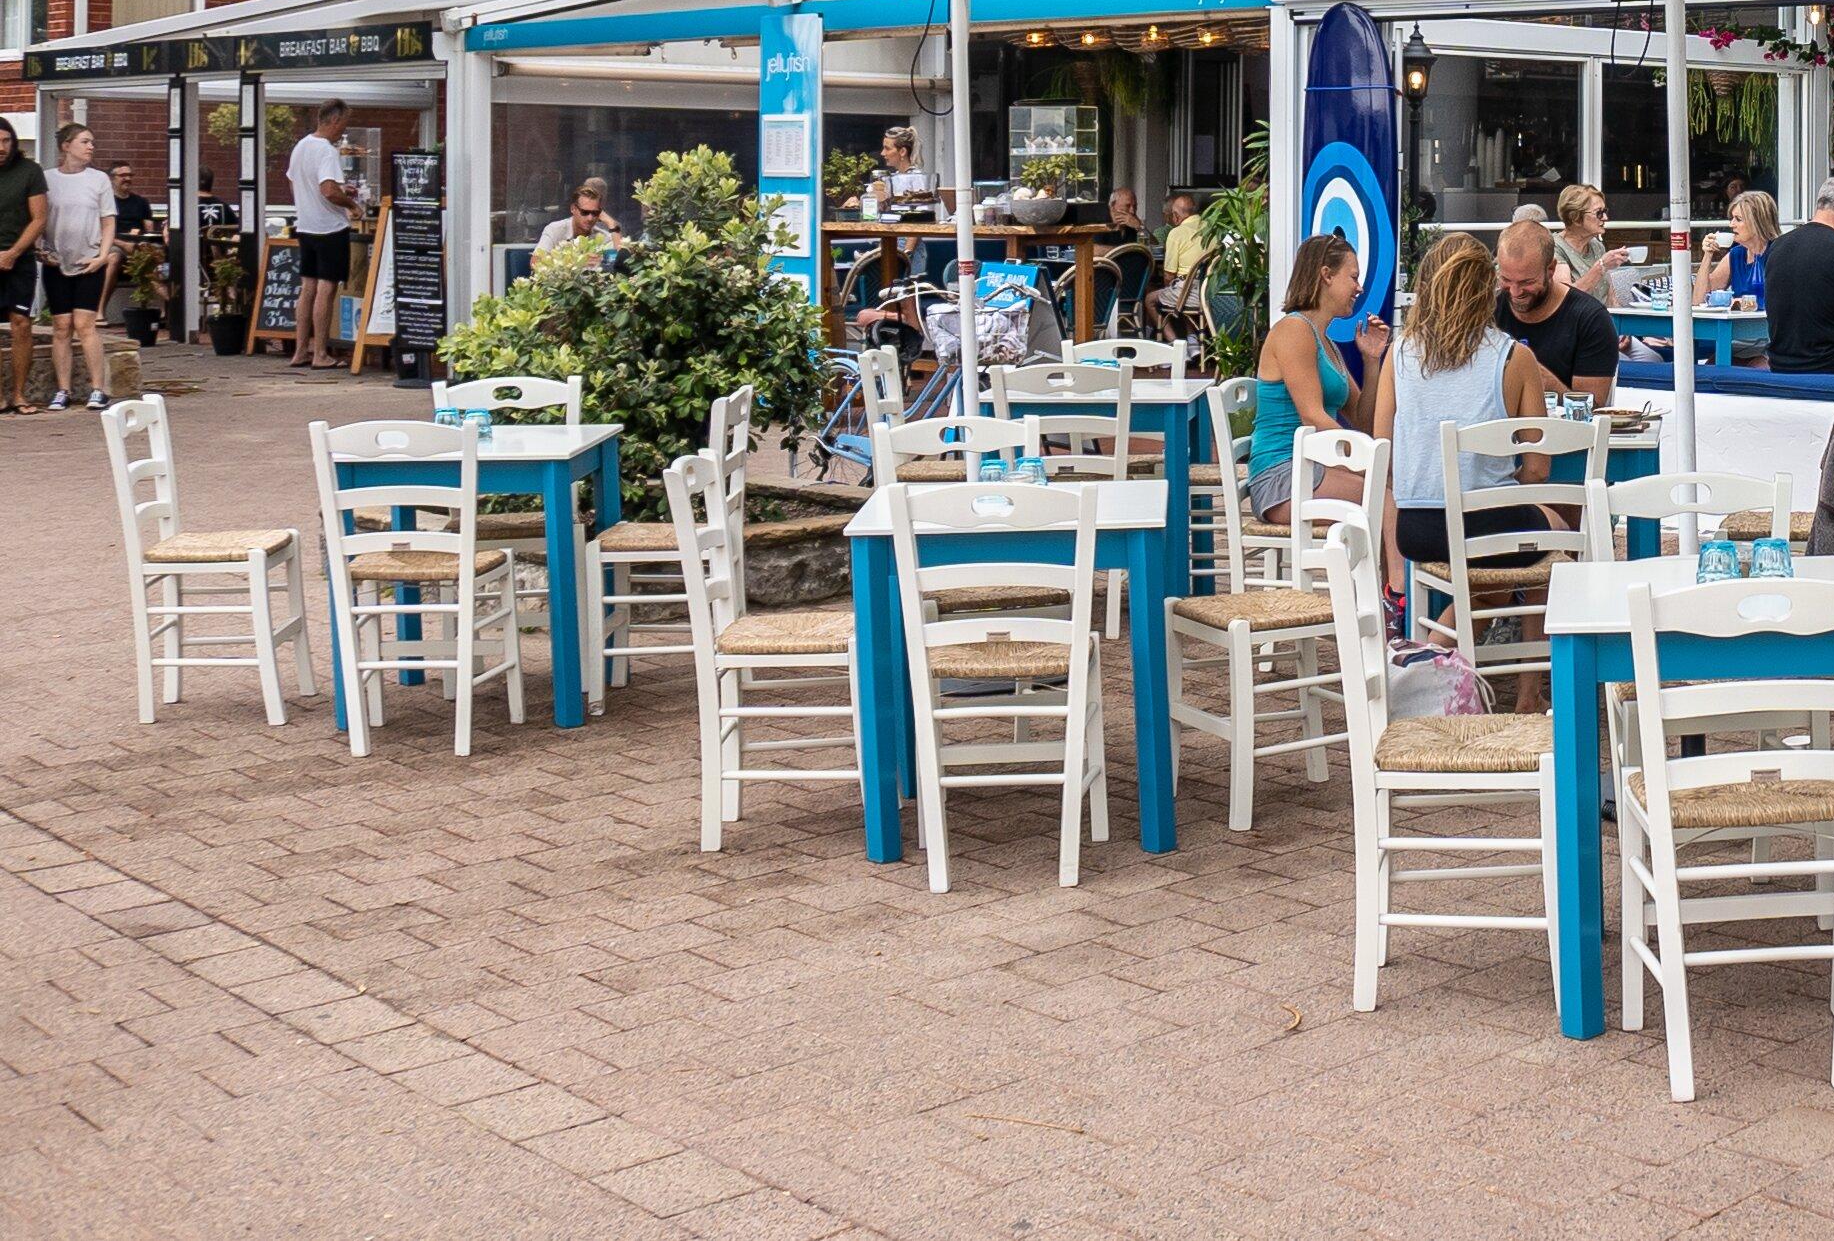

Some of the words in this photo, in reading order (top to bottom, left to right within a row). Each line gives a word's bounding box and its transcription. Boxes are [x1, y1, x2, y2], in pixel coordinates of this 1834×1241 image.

[279, 38, 327, 58] BREAKFAST
[328, 37, 348, 55] BAR
[360, 34, 380, 53] BBQ
[765, 52, 811, 82] jellyfish
